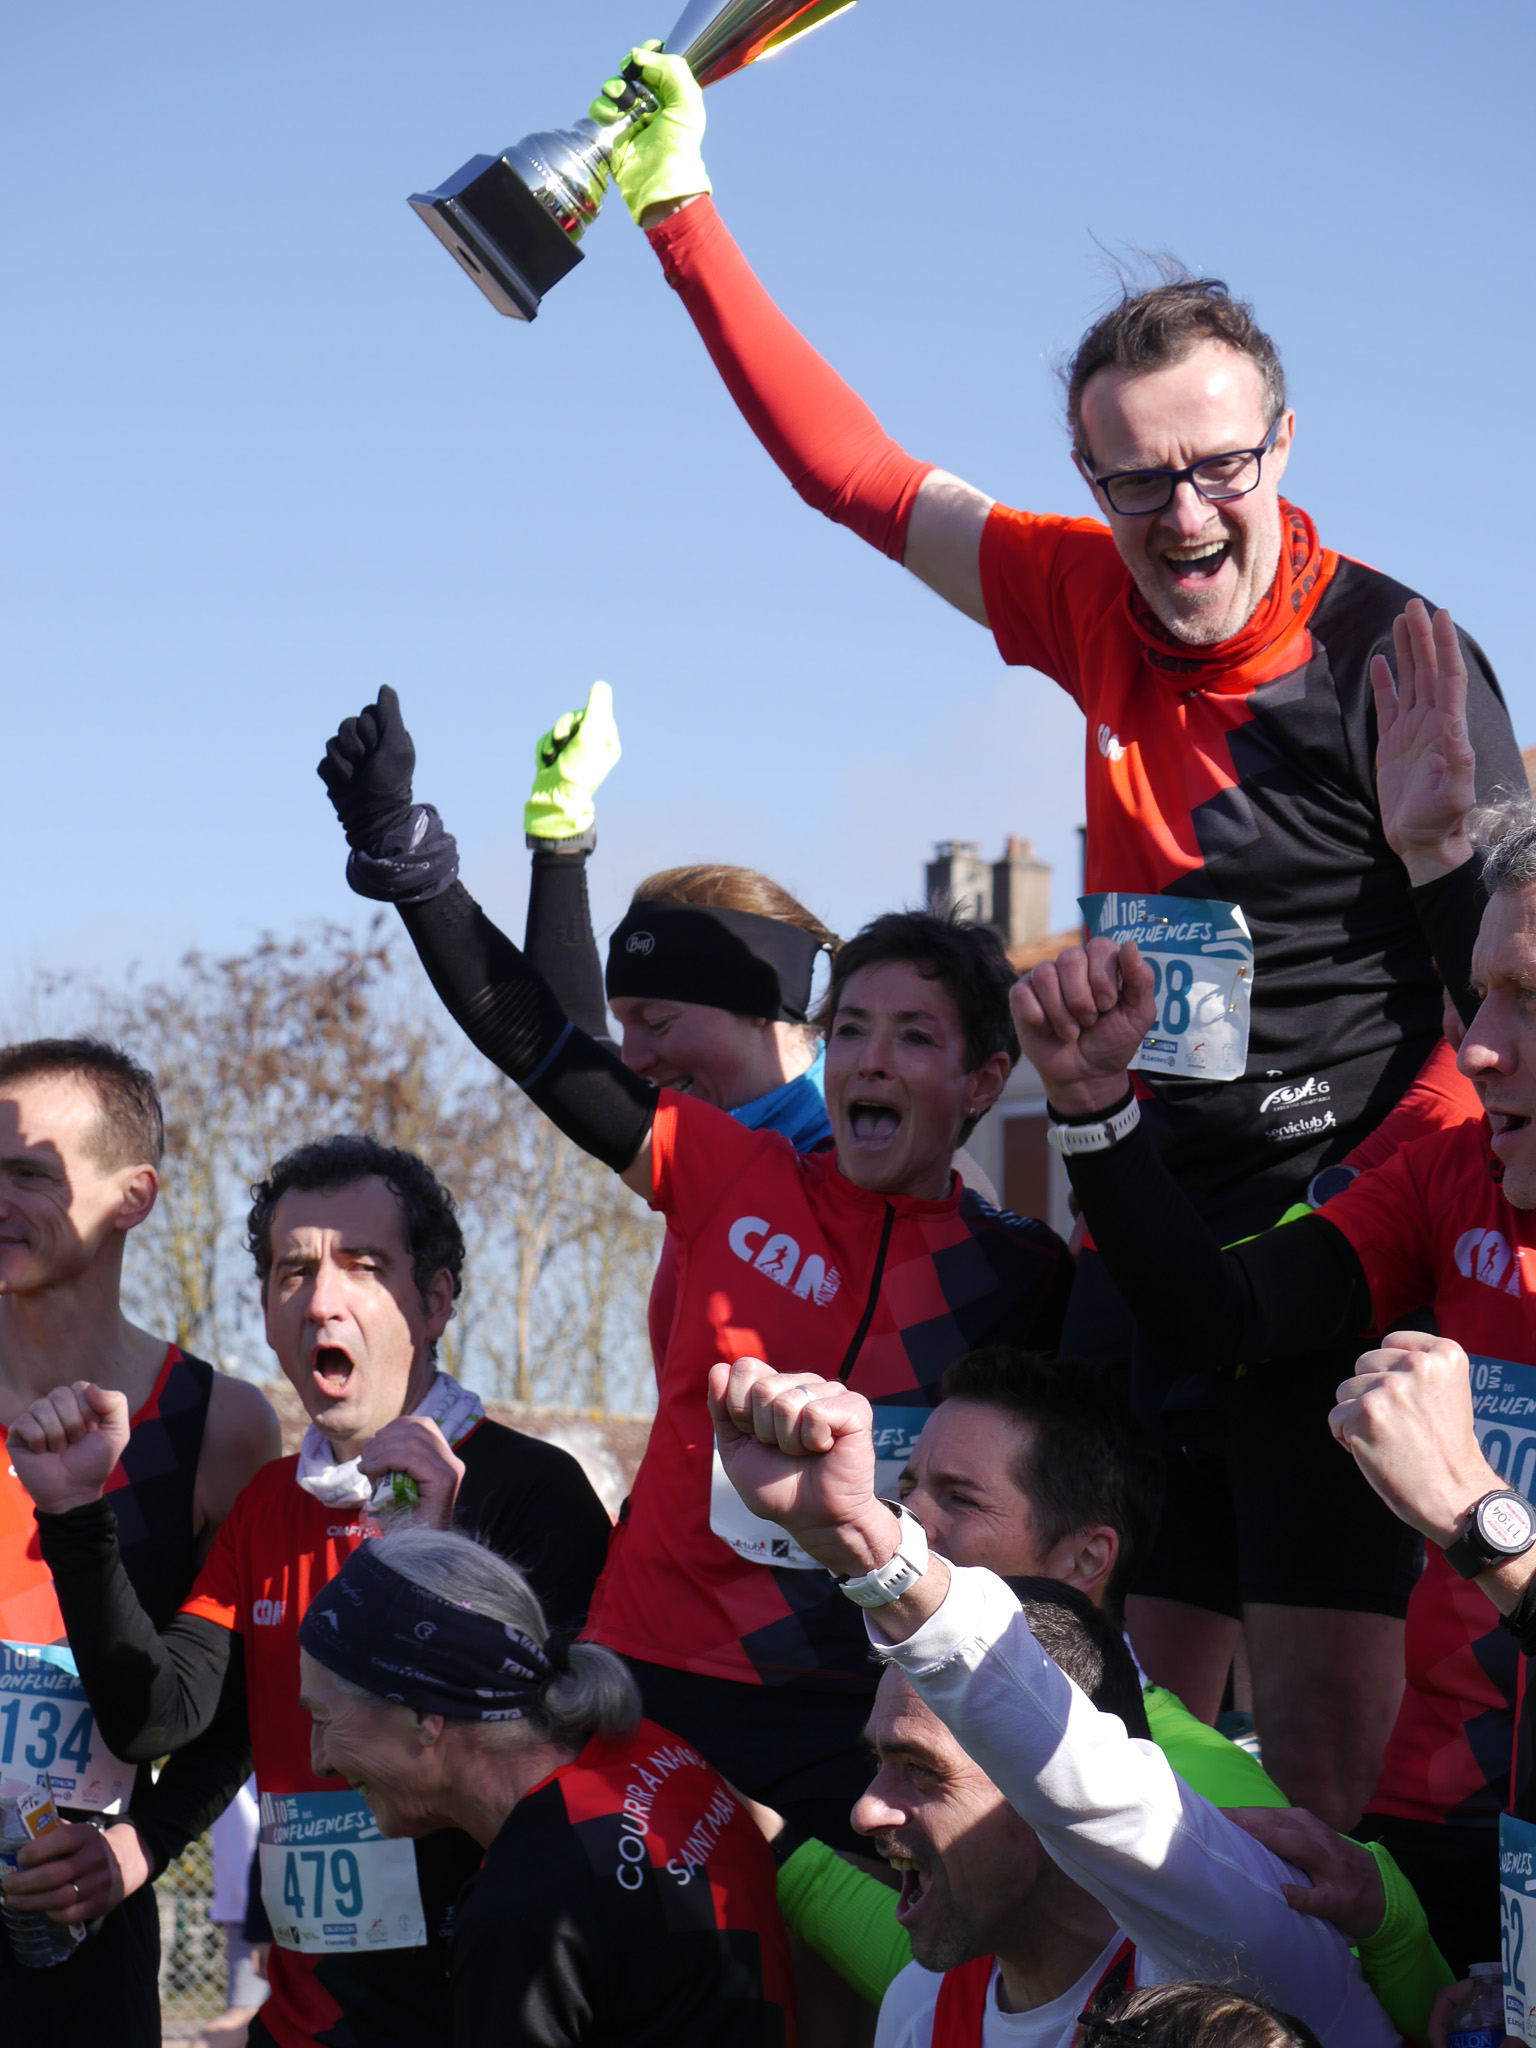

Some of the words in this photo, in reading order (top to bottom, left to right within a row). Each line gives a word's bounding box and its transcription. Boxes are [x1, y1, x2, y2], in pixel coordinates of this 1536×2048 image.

[1121, 900, 1138, 926] 10
[1265, 1116, 1323, 1138] serviclub
[728, 1215, 826, 1305] CAN
[3, 1648, 27, 1671] 10
[0, 1698, 94, 1775] 134
[272, 1811, 366, 1844] CONFLUENCES
[616, 1783, 655, 1891] COURIR
[666, 1818, 716, 1886] SAINT
[704, 1785, 736, 1836] MAX
[284, 1848, 364, 1919] 479
